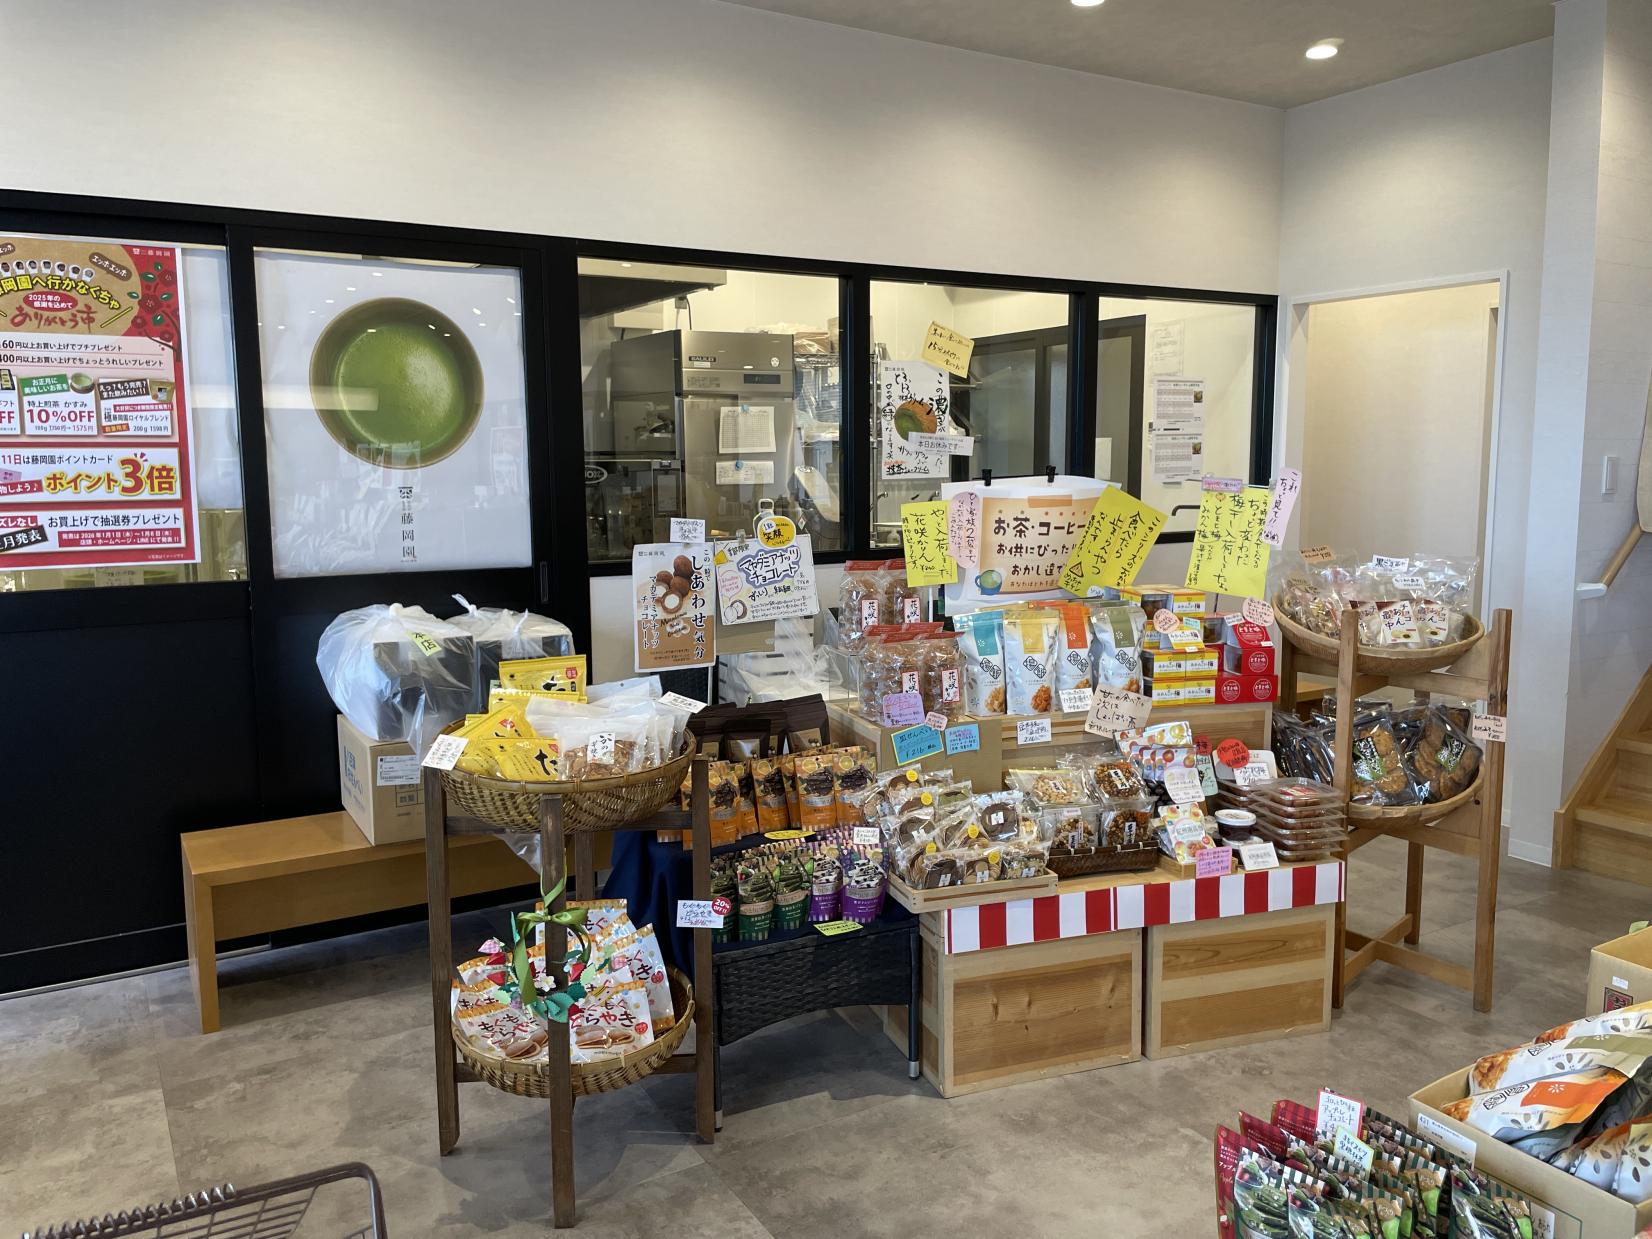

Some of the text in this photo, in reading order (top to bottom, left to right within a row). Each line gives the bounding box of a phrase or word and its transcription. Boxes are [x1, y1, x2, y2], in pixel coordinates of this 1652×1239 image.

[0, 275, 120, 310] 岡園へ行かなくちゃ
[0, 340, 123, 352] 60円以上お買い上げでプチプレゼント
[48, 513, 180, 528] お買上げで抽選券プレゼント
[690, 555, 706, 660] しあわせ気分
